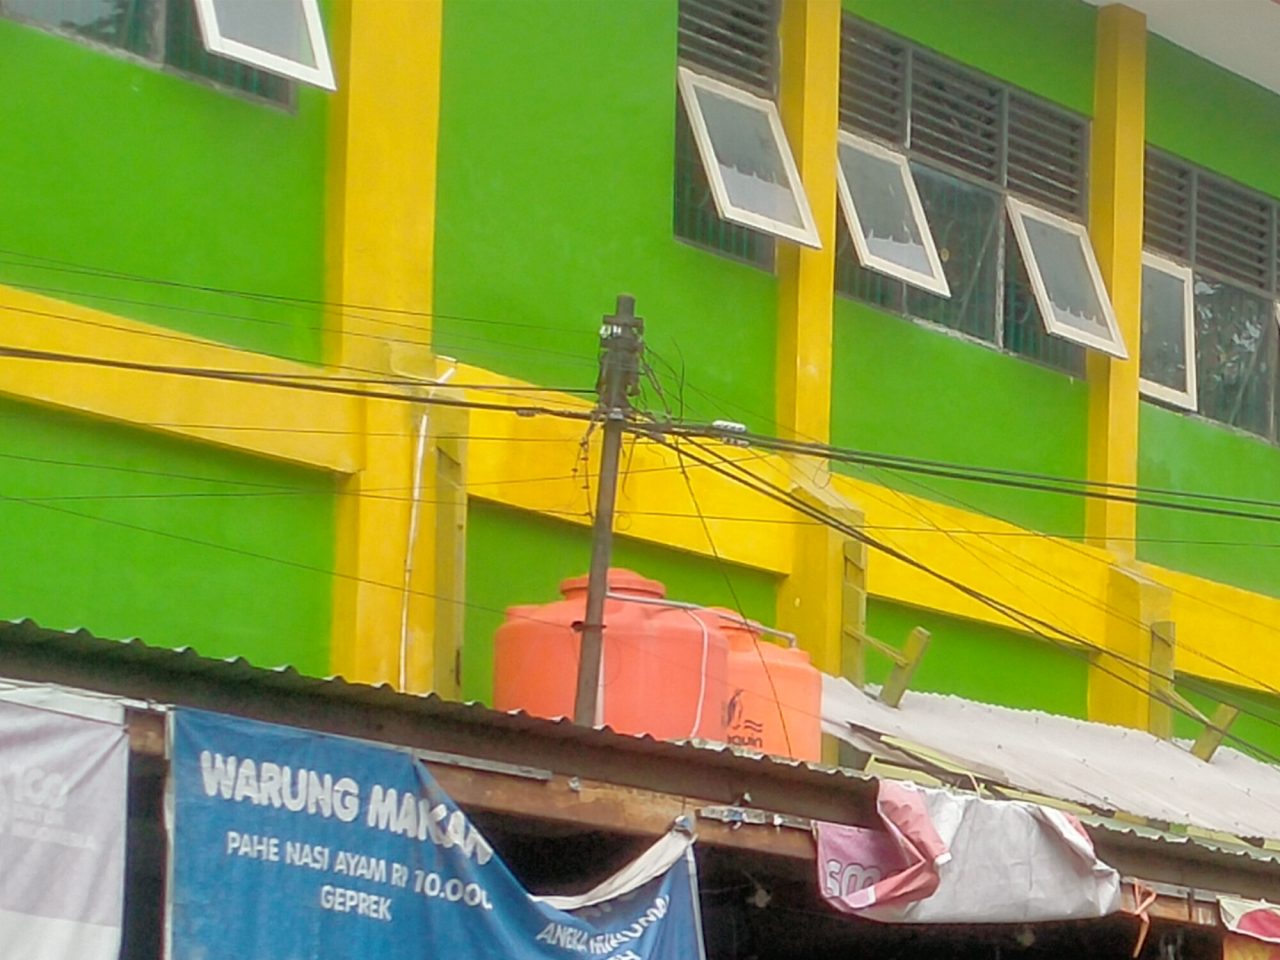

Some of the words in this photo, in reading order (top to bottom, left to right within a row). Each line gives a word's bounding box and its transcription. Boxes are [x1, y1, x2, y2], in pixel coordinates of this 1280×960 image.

[200, 750, 359, 822] WARUNG
[227, 831, 279, 862] PAHE
[285, 841, 328, 871] NASI
[334, 851, 386, 885] AYAM
[320, 885, 392, 922] GEPREK
